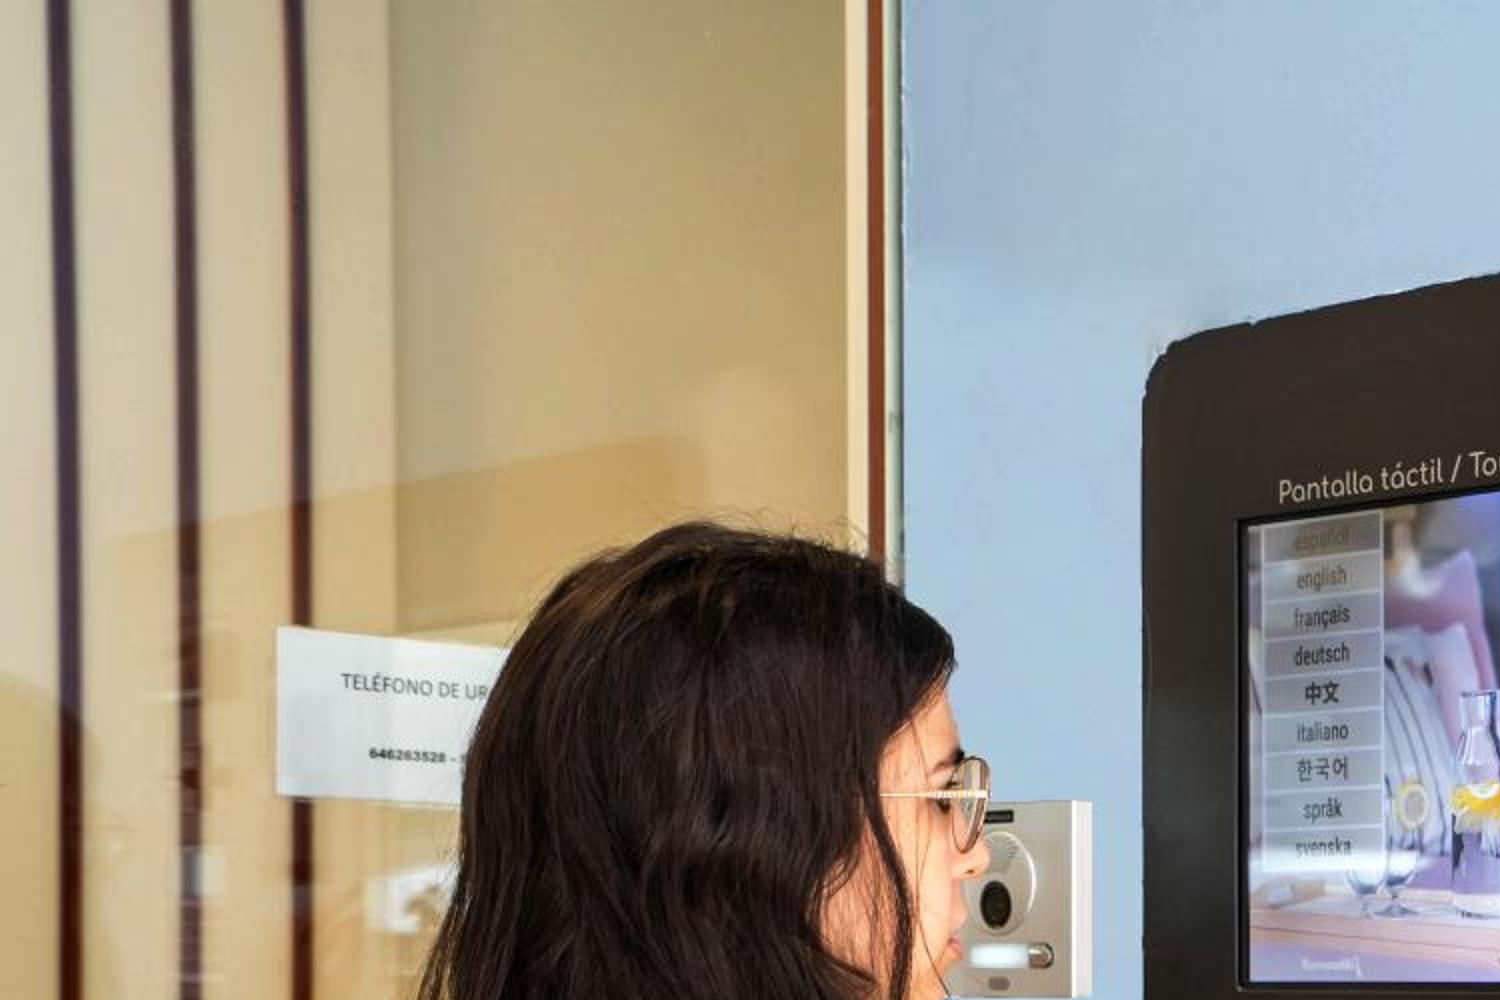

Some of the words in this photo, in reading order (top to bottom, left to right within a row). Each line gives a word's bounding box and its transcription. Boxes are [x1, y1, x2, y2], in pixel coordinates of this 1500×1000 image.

[1278, 470, 1373, 504] Pantalla
[1381, 457, 1444, 490] táctil
[1450, 455, 1462, 483] /
[1297, 564, 1347, 592] english
[1294, 605, 1351, 630] français
[1294, 641, 1350, 666] deutsch
[341, 672, 433, 698] TELÉFONO
[438, 681, 460, 699] DE
[465, 684, 489, 701] UR
[1305, 680, 1339, 705] 中文
[1297, 720, 1349, 743] italiano
[1297, 756, 1348, 782] 한국어
[1303, 796, 1343, 823] språk
